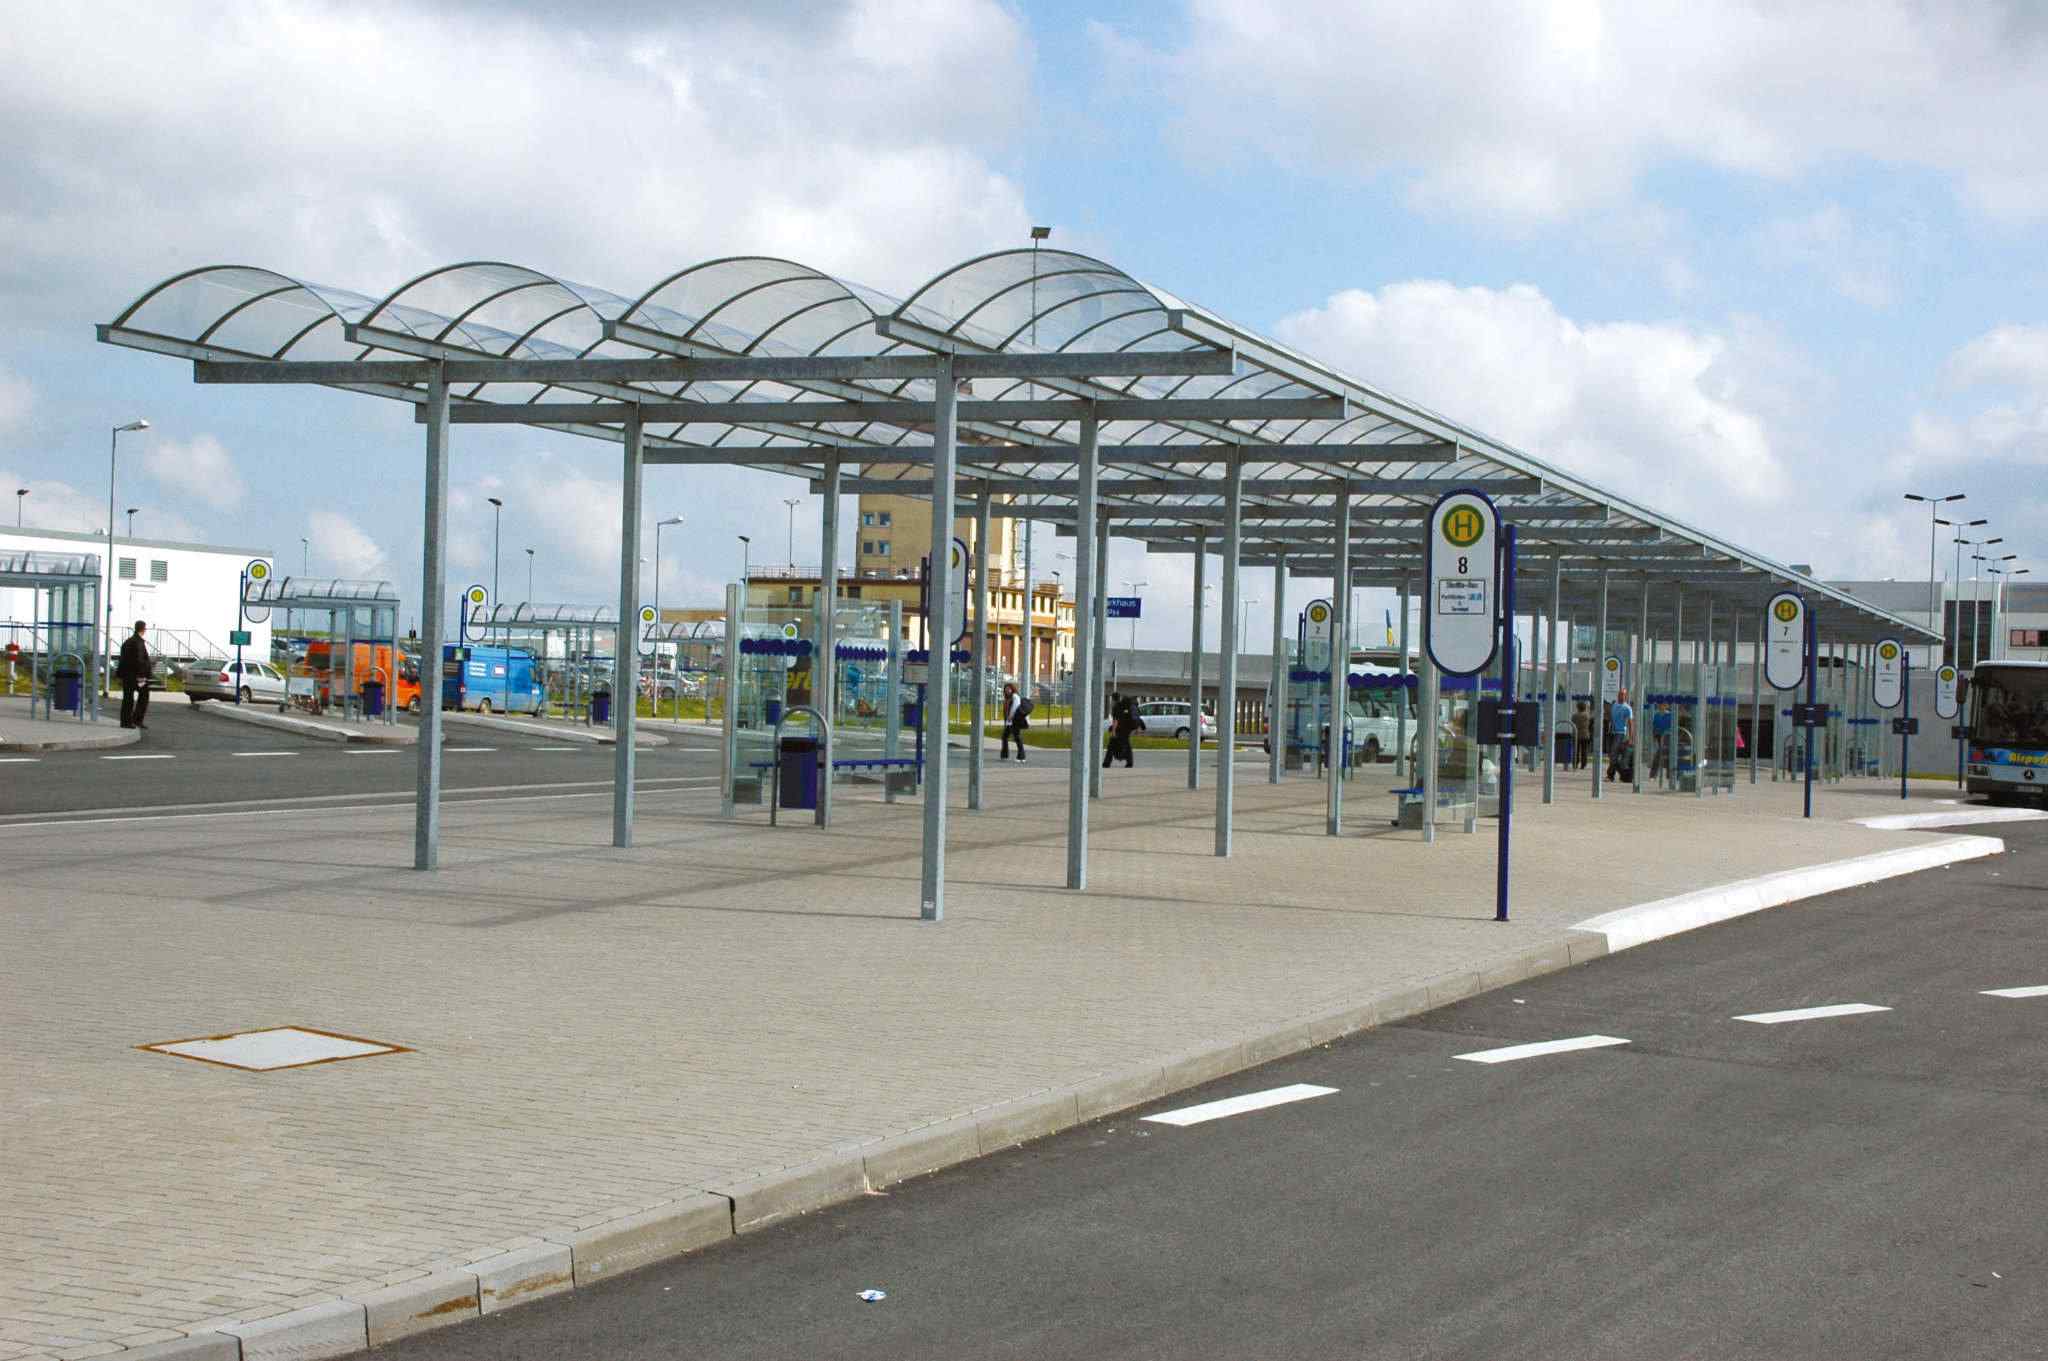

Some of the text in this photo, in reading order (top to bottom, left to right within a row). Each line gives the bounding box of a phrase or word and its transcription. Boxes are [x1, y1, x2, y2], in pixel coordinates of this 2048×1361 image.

[1455, 513, 1472, 536] H
[1458, 556, 1468, 574] 8
[1783, 626, 1788, 636] 7
